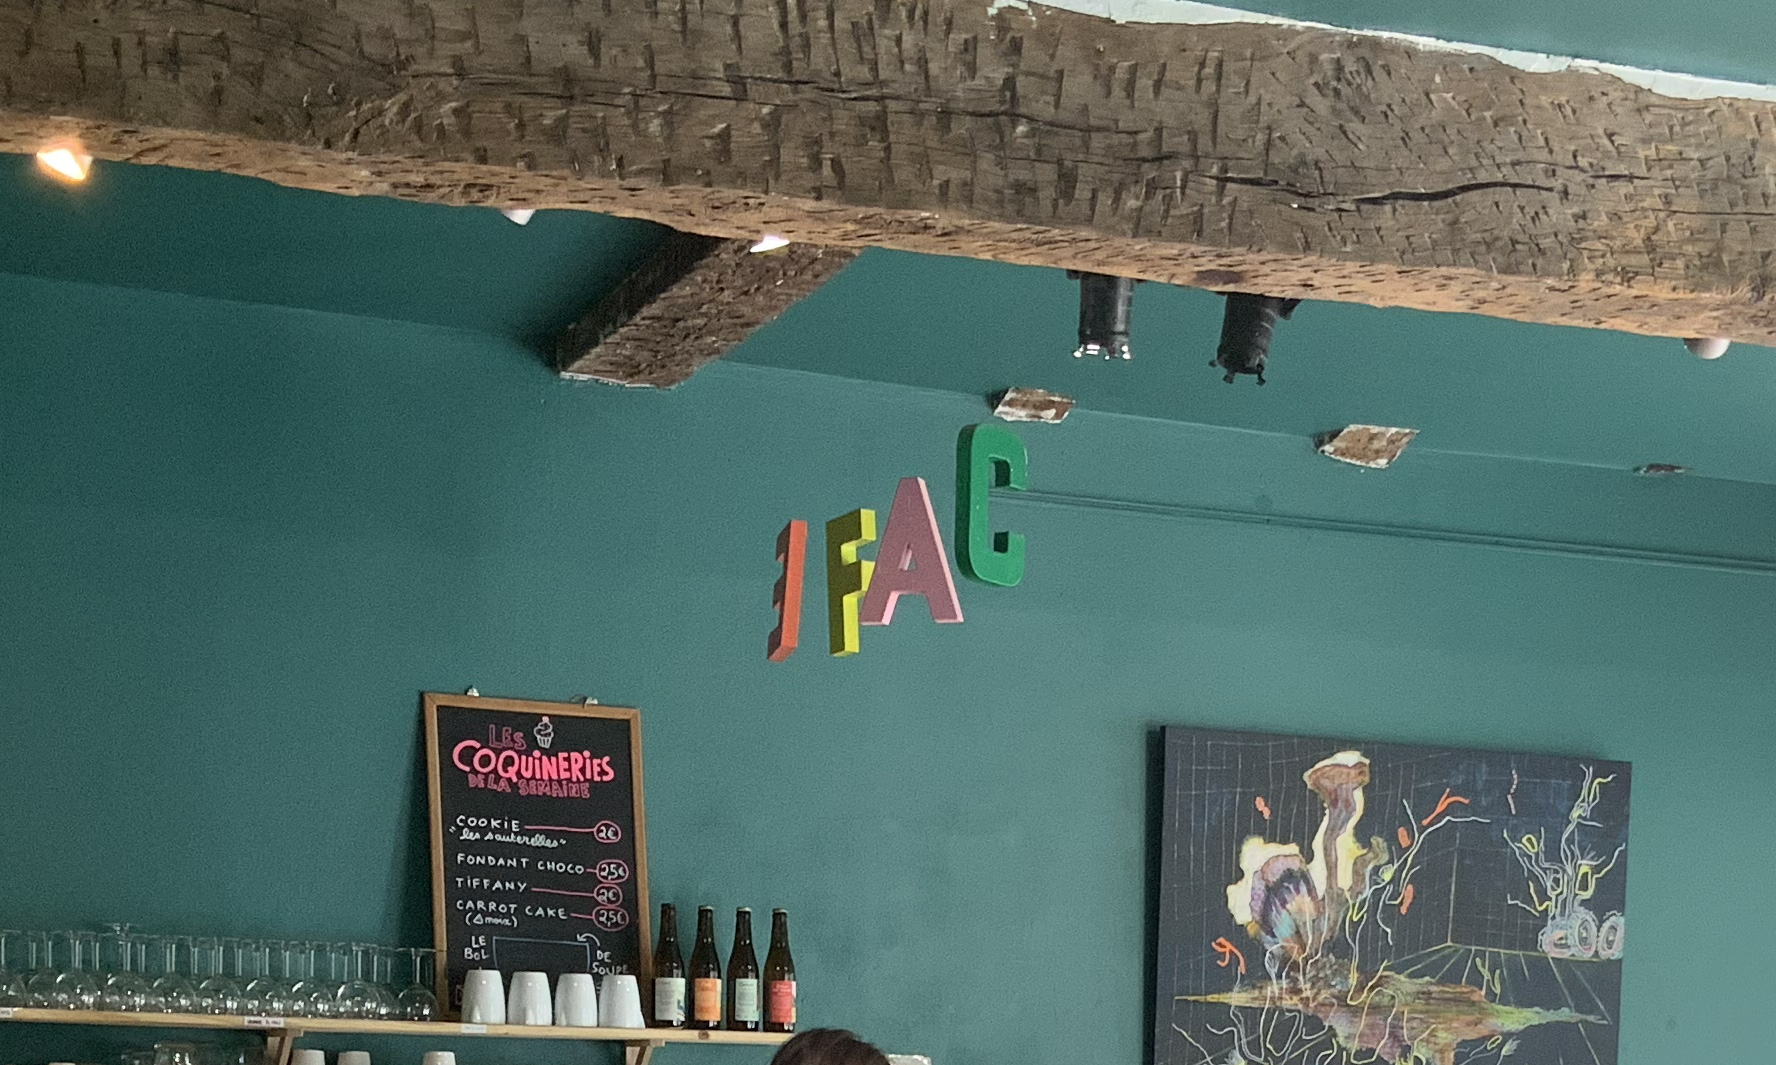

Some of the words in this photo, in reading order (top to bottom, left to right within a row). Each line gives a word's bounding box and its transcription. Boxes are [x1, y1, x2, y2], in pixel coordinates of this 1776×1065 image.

[489, 724, 526, 750] LES
[468, 774, 485, 788] DE
[487, 774, 511, 793] LA
[598, 826, 616, 840] 2€
[457, 853, 529, 868] FONDANT
[537, 861, 584, 874] CHOCO
[456, 900, 518, 914] CARROT
[525, 905, 568, 920] CAKE
[471, 936, 487, 949] LE
[597, 950, 612, 963] DE
